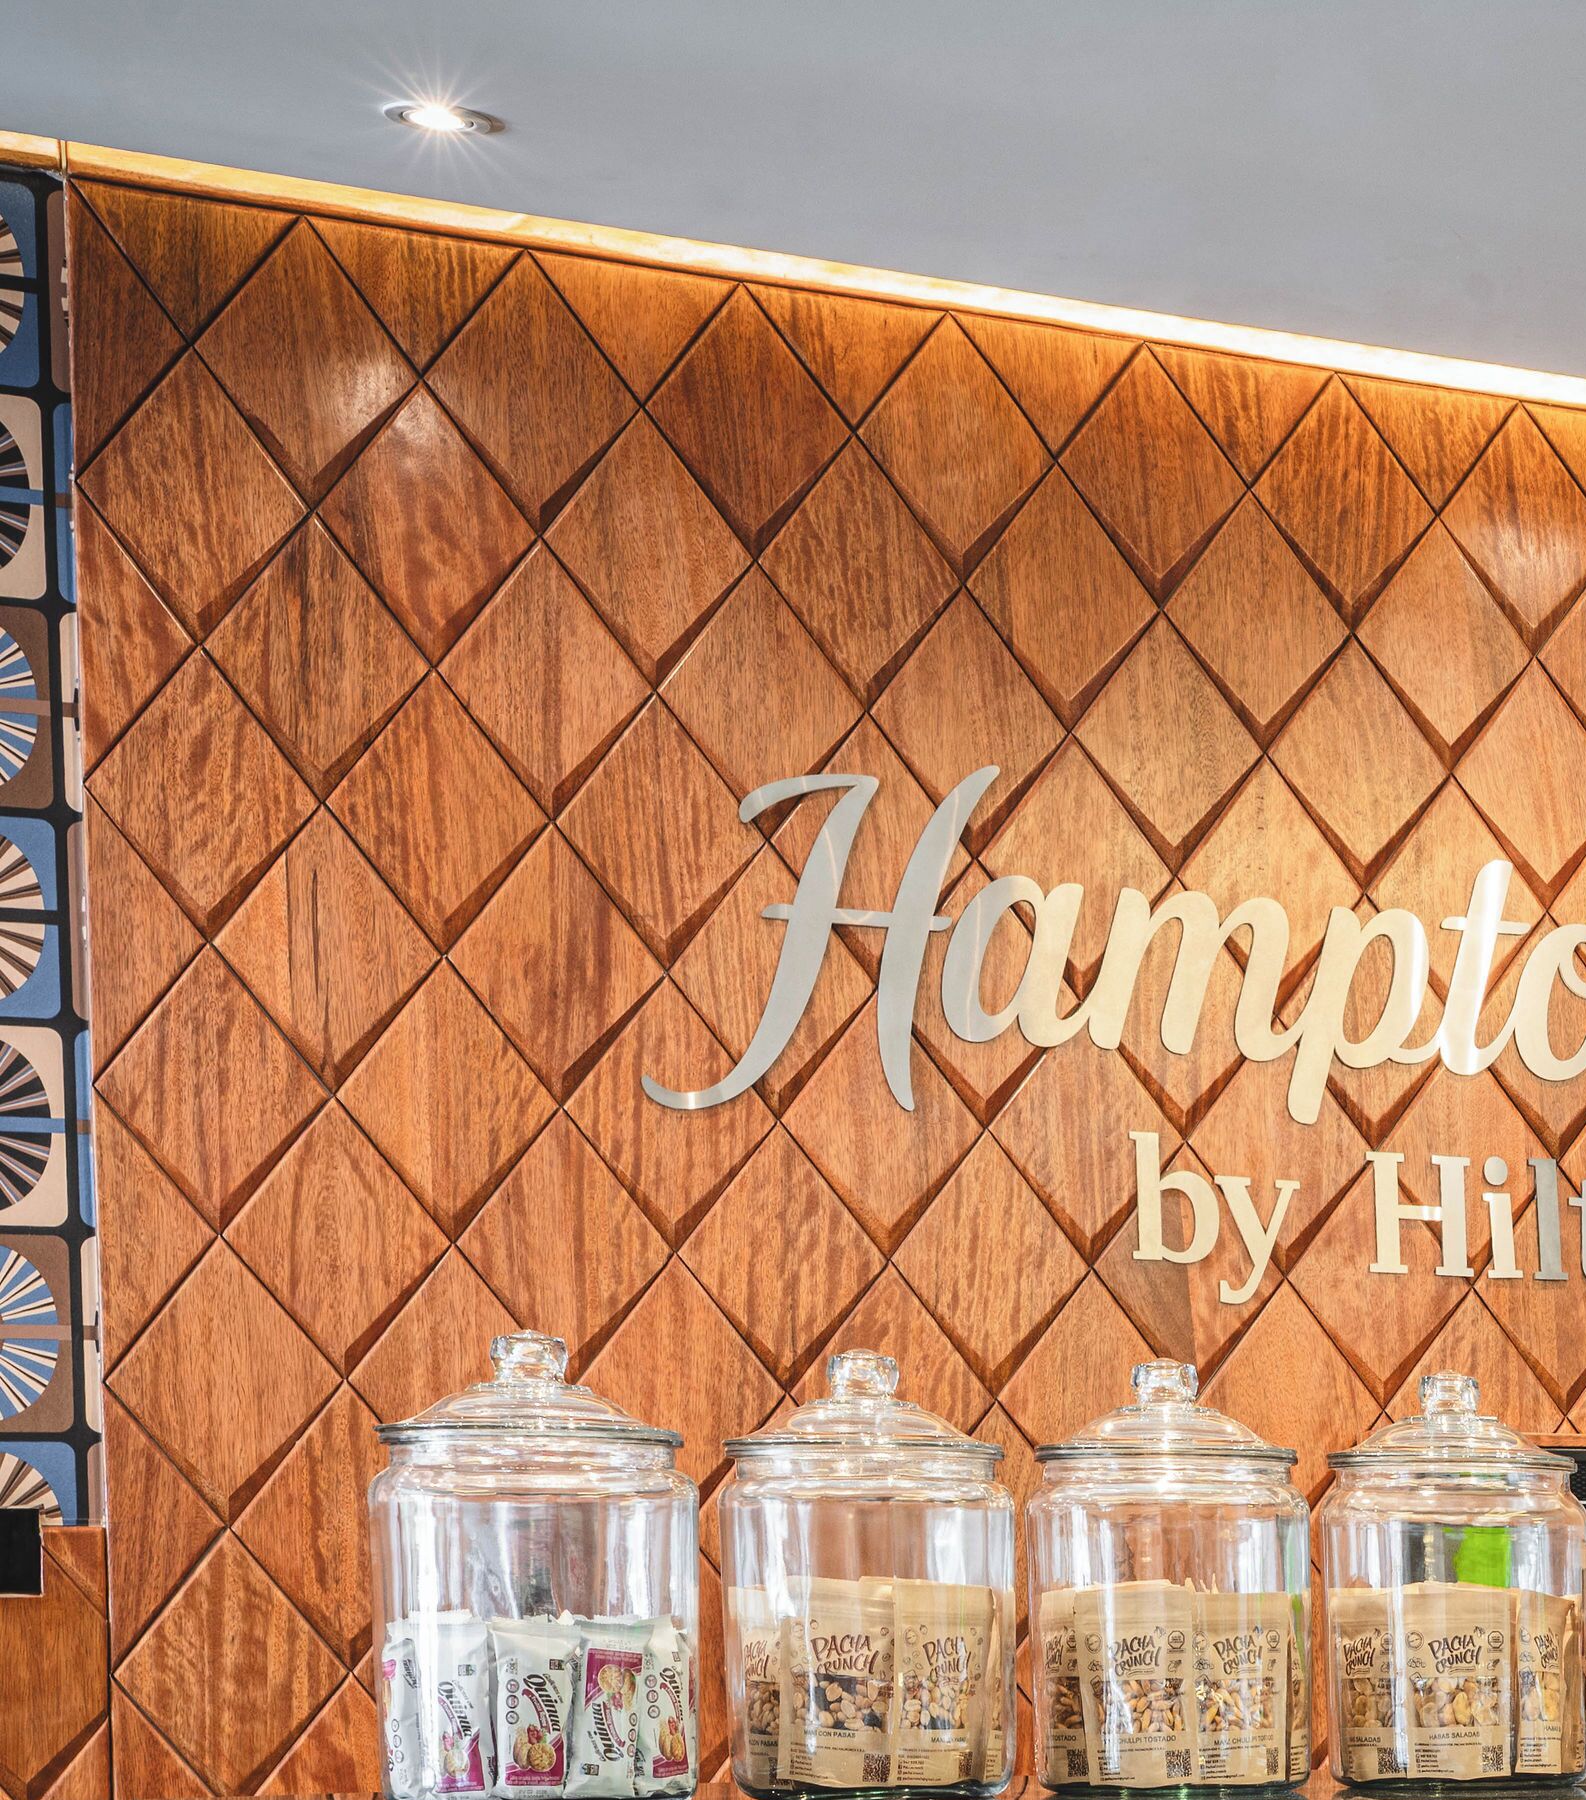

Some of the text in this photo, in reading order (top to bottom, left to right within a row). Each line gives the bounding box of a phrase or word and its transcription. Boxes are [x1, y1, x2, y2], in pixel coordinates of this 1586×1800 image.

[1129, 1130, 1300, 1304] by
[810, 1634, 872, 1661] PACHA
[1213, 1634, 1257, 1661] PACHA
[1343, 1636, 1374, 1662] PACHA
[1428, 1635, 1476, 1660] PACHA
[1435, 1645, 1482, 1674] CRUNCH
[816, 1650, 879, 1675] CRUNCH
[1114, 1646, 1163, 1677] CRUNCH
[1345, 1647, 1376, 1677] CRUNCH
[523, 1673, 562, 1732] Quinua
[1143, 1735, 1177, 1743] TOSTADO
[1451, 1731, 1480, 1739] SALADAS
